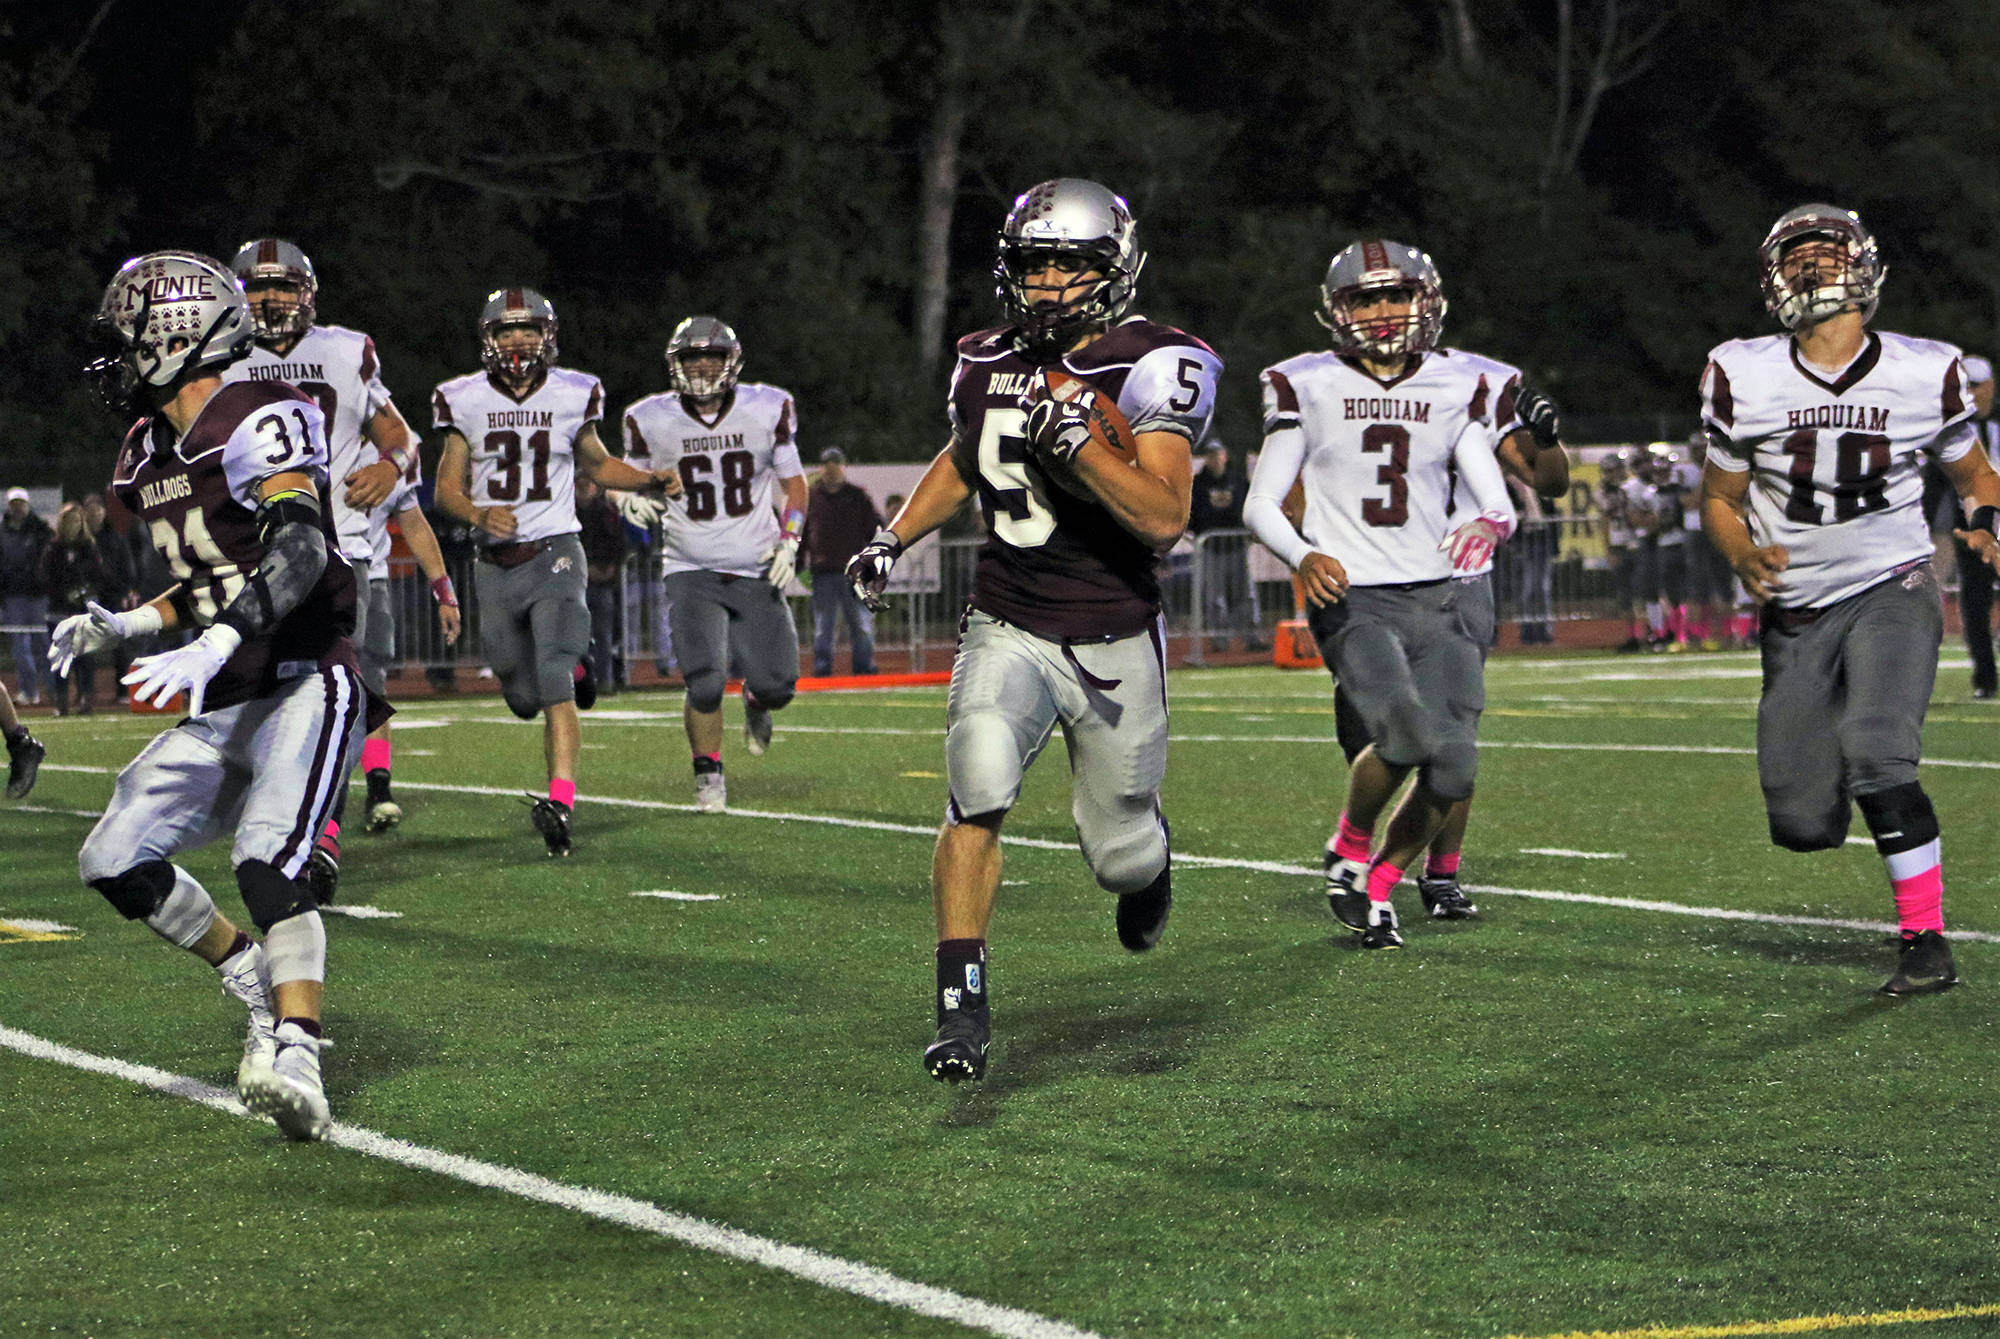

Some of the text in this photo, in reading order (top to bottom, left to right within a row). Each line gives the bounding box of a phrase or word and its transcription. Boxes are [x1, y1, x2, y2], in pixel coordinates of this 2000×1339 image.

[124, 275, 216, 312] MONTE
[247, 363, 324, 382] HOQUIAM
[1168, 358, 1203, 413] 5
[487, 411, 553, 429] HOQUIAM
[1343, 398, 1431, 424] HOQUIAM
[1786, 404, 1890, 432] HOQUIAM
[255, 407, 316, 465] 31
[682, 433, 744, 452] HOQUIAM
[483, 430, 553, 502] 31
[678, 450, 755, 522] 68
[979, 407, 1057, 548] 5
[1361, 423, 1411, 528] 3
[1782, 430, 1892, 527] 18
[139, 473, 192, 509] BULLDOGS
